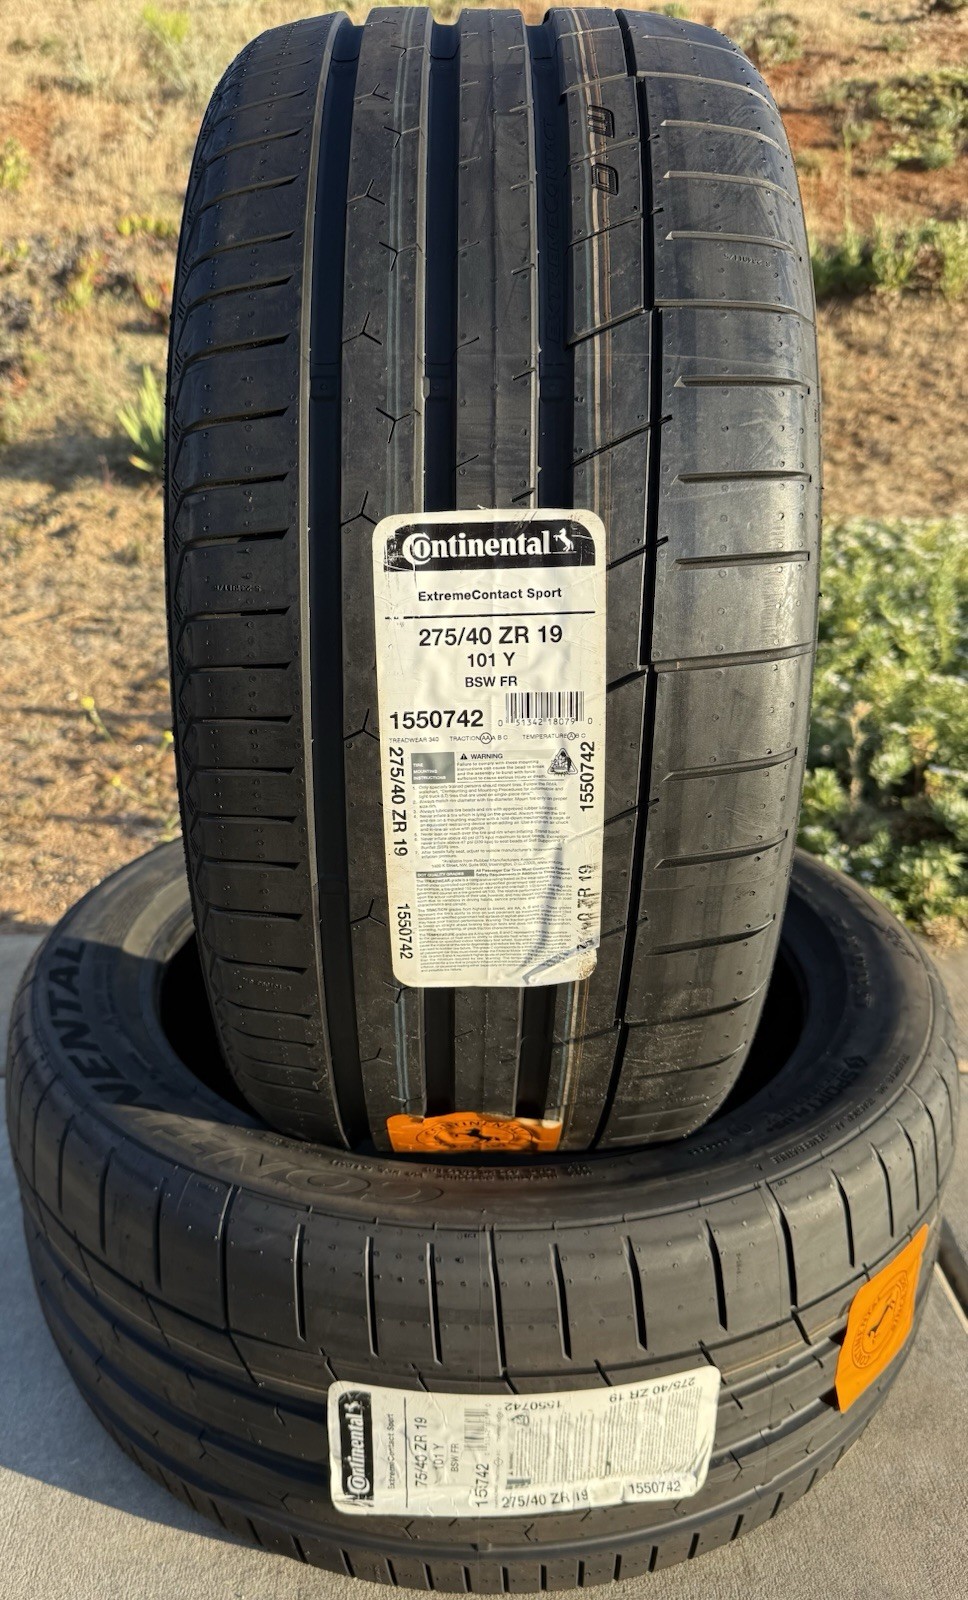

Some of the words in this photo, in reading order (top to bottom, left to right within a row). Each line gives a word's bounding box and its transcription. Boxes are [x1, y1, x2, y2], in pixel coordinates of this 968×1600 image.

[402, 530, 551, 565] Continental
[418, 590, 523, 601] ExtremeContact
[526, 587, 562, 600] Sport
[419, 626, 492, 646] 275/40
[499, 625, 529, 644] ZR
[538, 624, 563, 643] 19
[467, 653, 496, 667] 101
[503, 652, 516, 666] Y
[465, 676, 496, 688] BSW
[500, 675, 518, 687] FR
[389, 710, 484, 729] 1550742
[389, 747, 406, 805] 275/40
[580, 741, 595, 812] 1550742
[392, 809, 407, 832] ZR
[393, 838, 408, 856] 19
[578, 864, 592, 882] 19
[397, 903, 414, 959] 1550742
[629, 1388, 649, 1399] ZR
[653, 1376, 696, 1394] 275/40
[609, 1392, 623, 1403] 19
[386, 1413, 395, 1431] Sport
[414, 1417, 427, 1430] 19
[414, 1434, 427, 1451] ZR
[433, 1442, 444, 1450] Y
[450, 1443, 459, 1453] FR
[345, 1413, 370, 1494] Continental
[451, 1455, 459, 1473] BSW
[629, 1480, 681, 1494] 1550742
[501, 1496, 547, 1508] 275/40
[551, 1491, 571, 1503] ZR
[575, 1489, 589, 1501] 19
